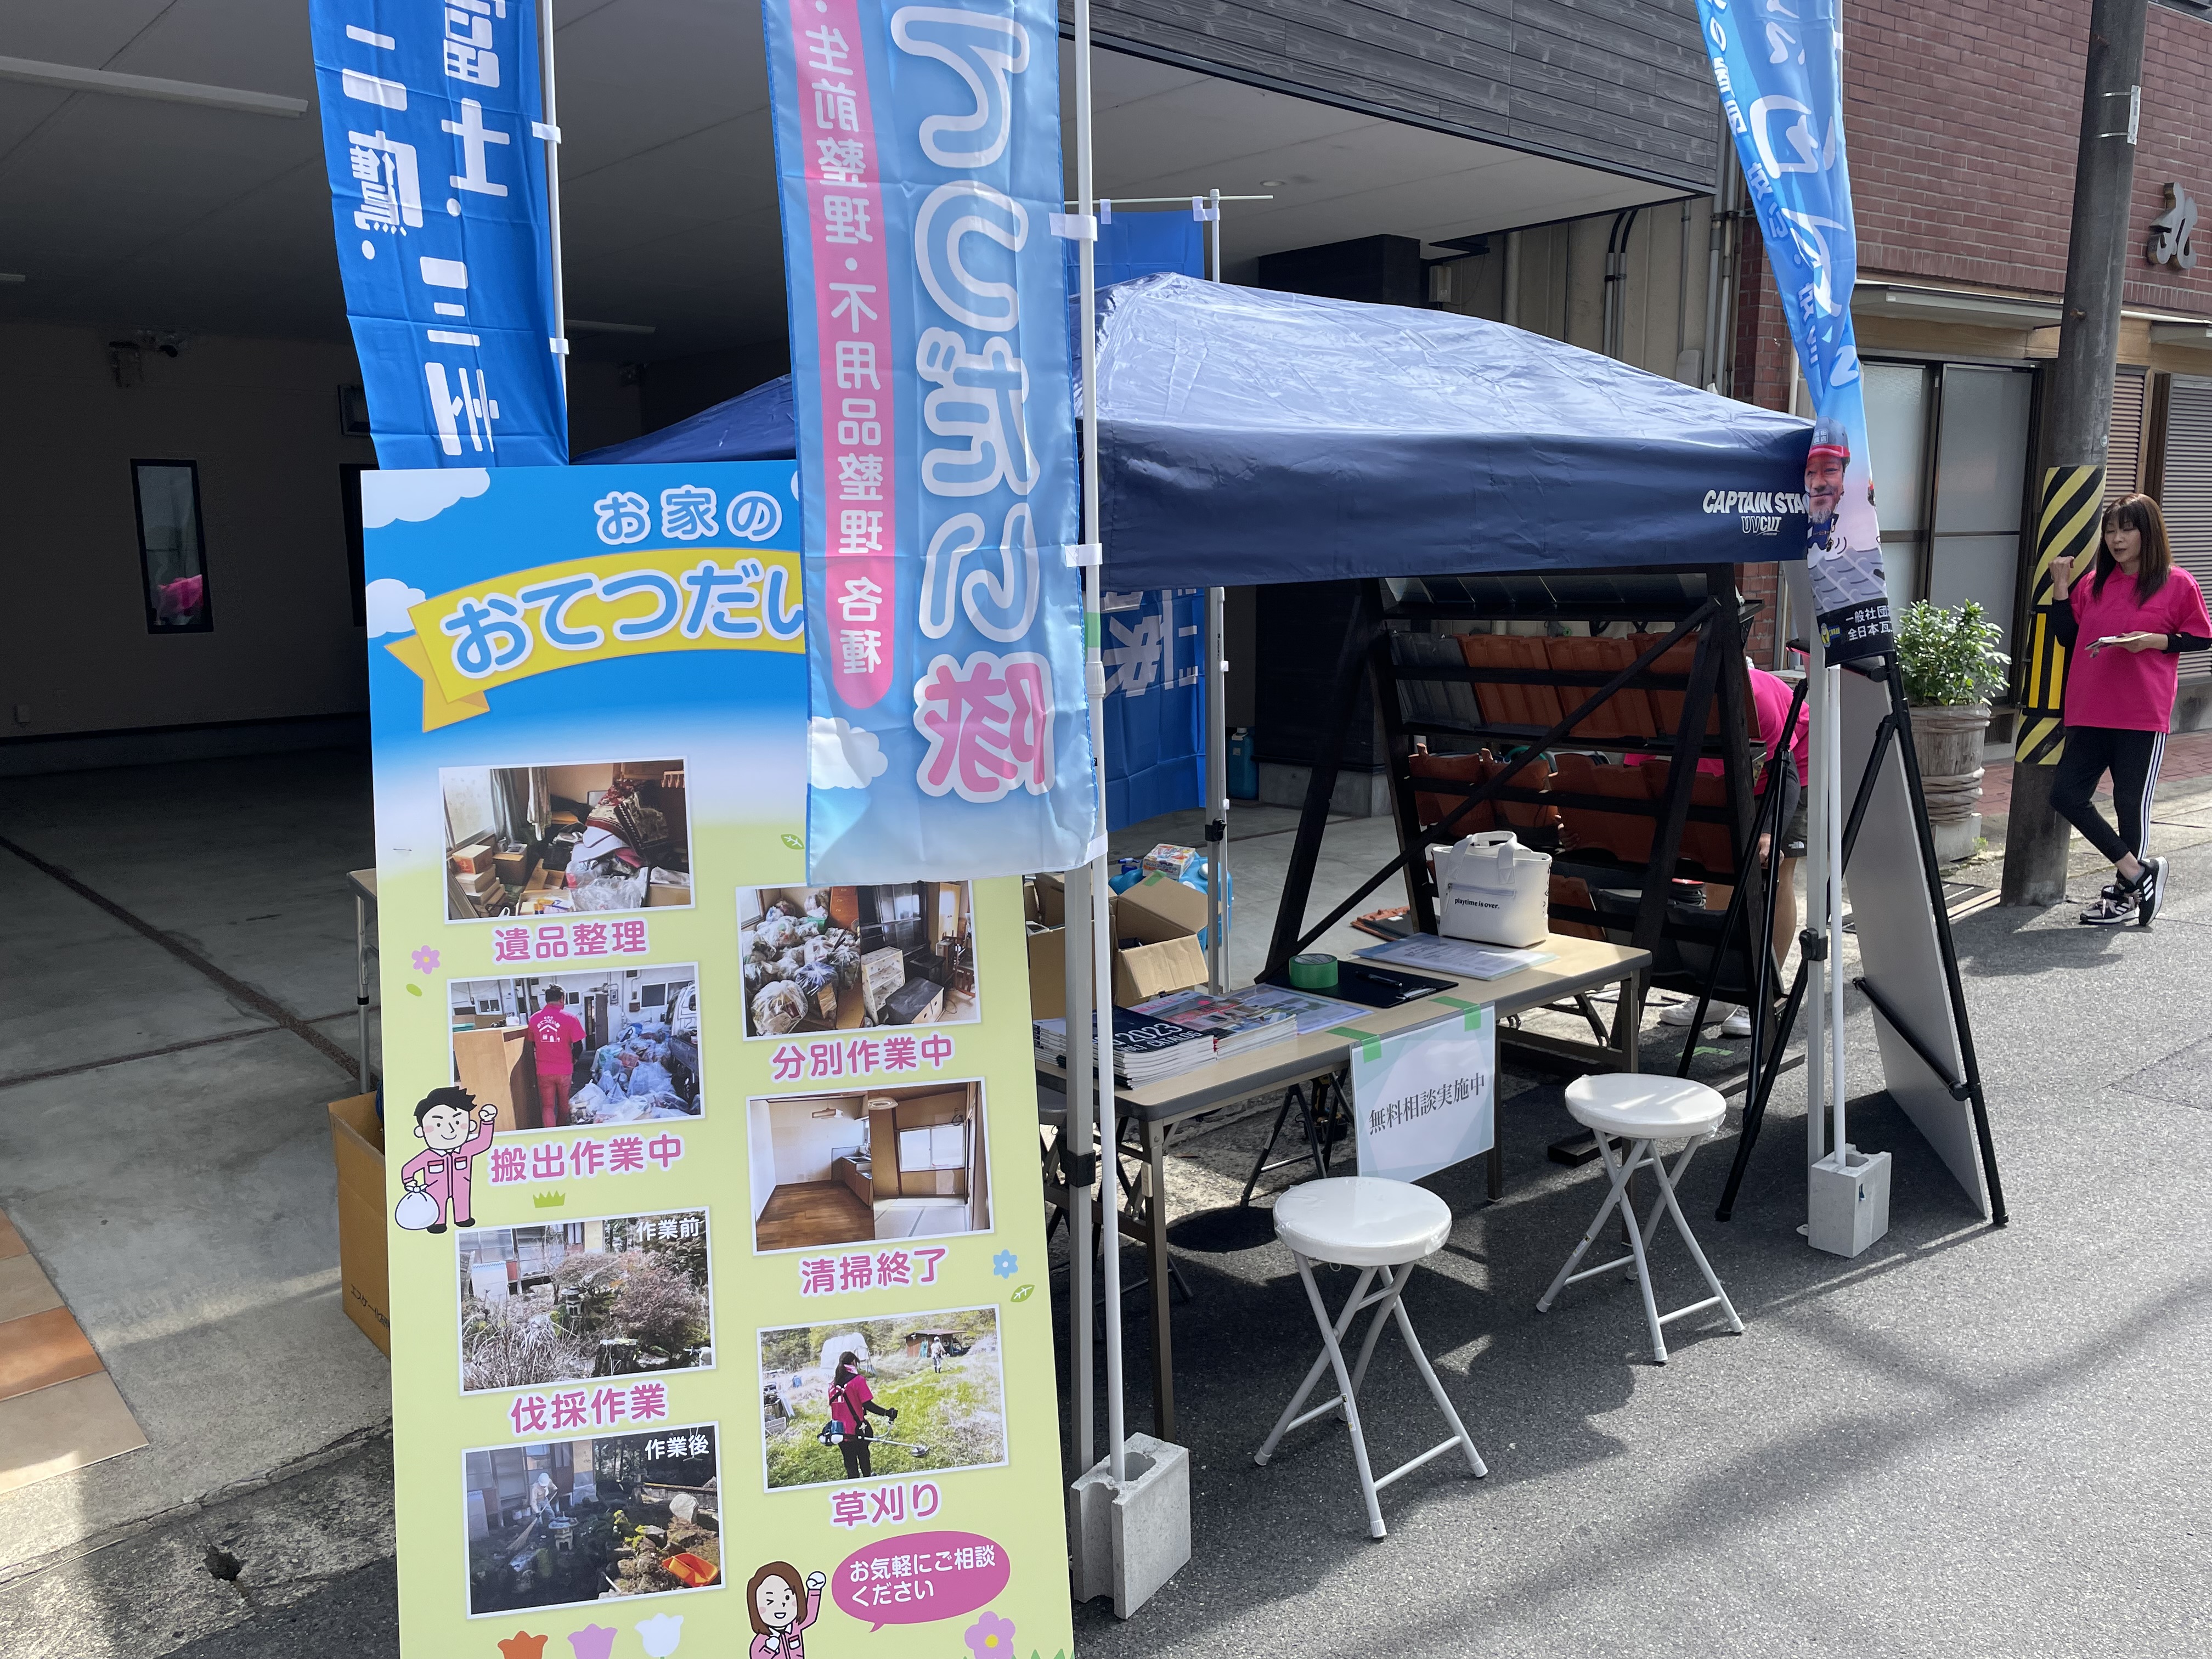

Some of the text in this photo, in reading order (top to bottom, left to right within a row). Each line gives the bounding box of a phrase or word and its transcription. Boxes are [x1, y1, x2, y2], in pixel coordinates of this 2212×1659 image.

[596, 486, 781, 544] お家の
[1702, 489, 1809, 514] CAPTAIN STA
[1845, 605, 1890, 623] 一般社団
[1454, 897, 1477, 907] playtime
[493, 918, 648, 964] 遺品整理
[1114, 1023, 1183, 1043] 2023
[1147, 1031, 1203, 1048] CATALOG
[771, 1034, 953, 1081] 分別作業中
[1368, 1071, 1486, 1136] 無料相談実施中
[490, 1133, 682, 1183] 搬出作業中
[635, 1217, 701, 1243] 作業前
[799, 1248, 947, 1295] 清掃終了
[510, 1381, 667, 1434] 伐採作業
[644, 1434, 710, 1462] 作業後
[831, 1483, 940, 1527] 草刈り
[849, 1544, 996, 1583] お気軽にご相談
[851, 1581, 935, 1608] ください
